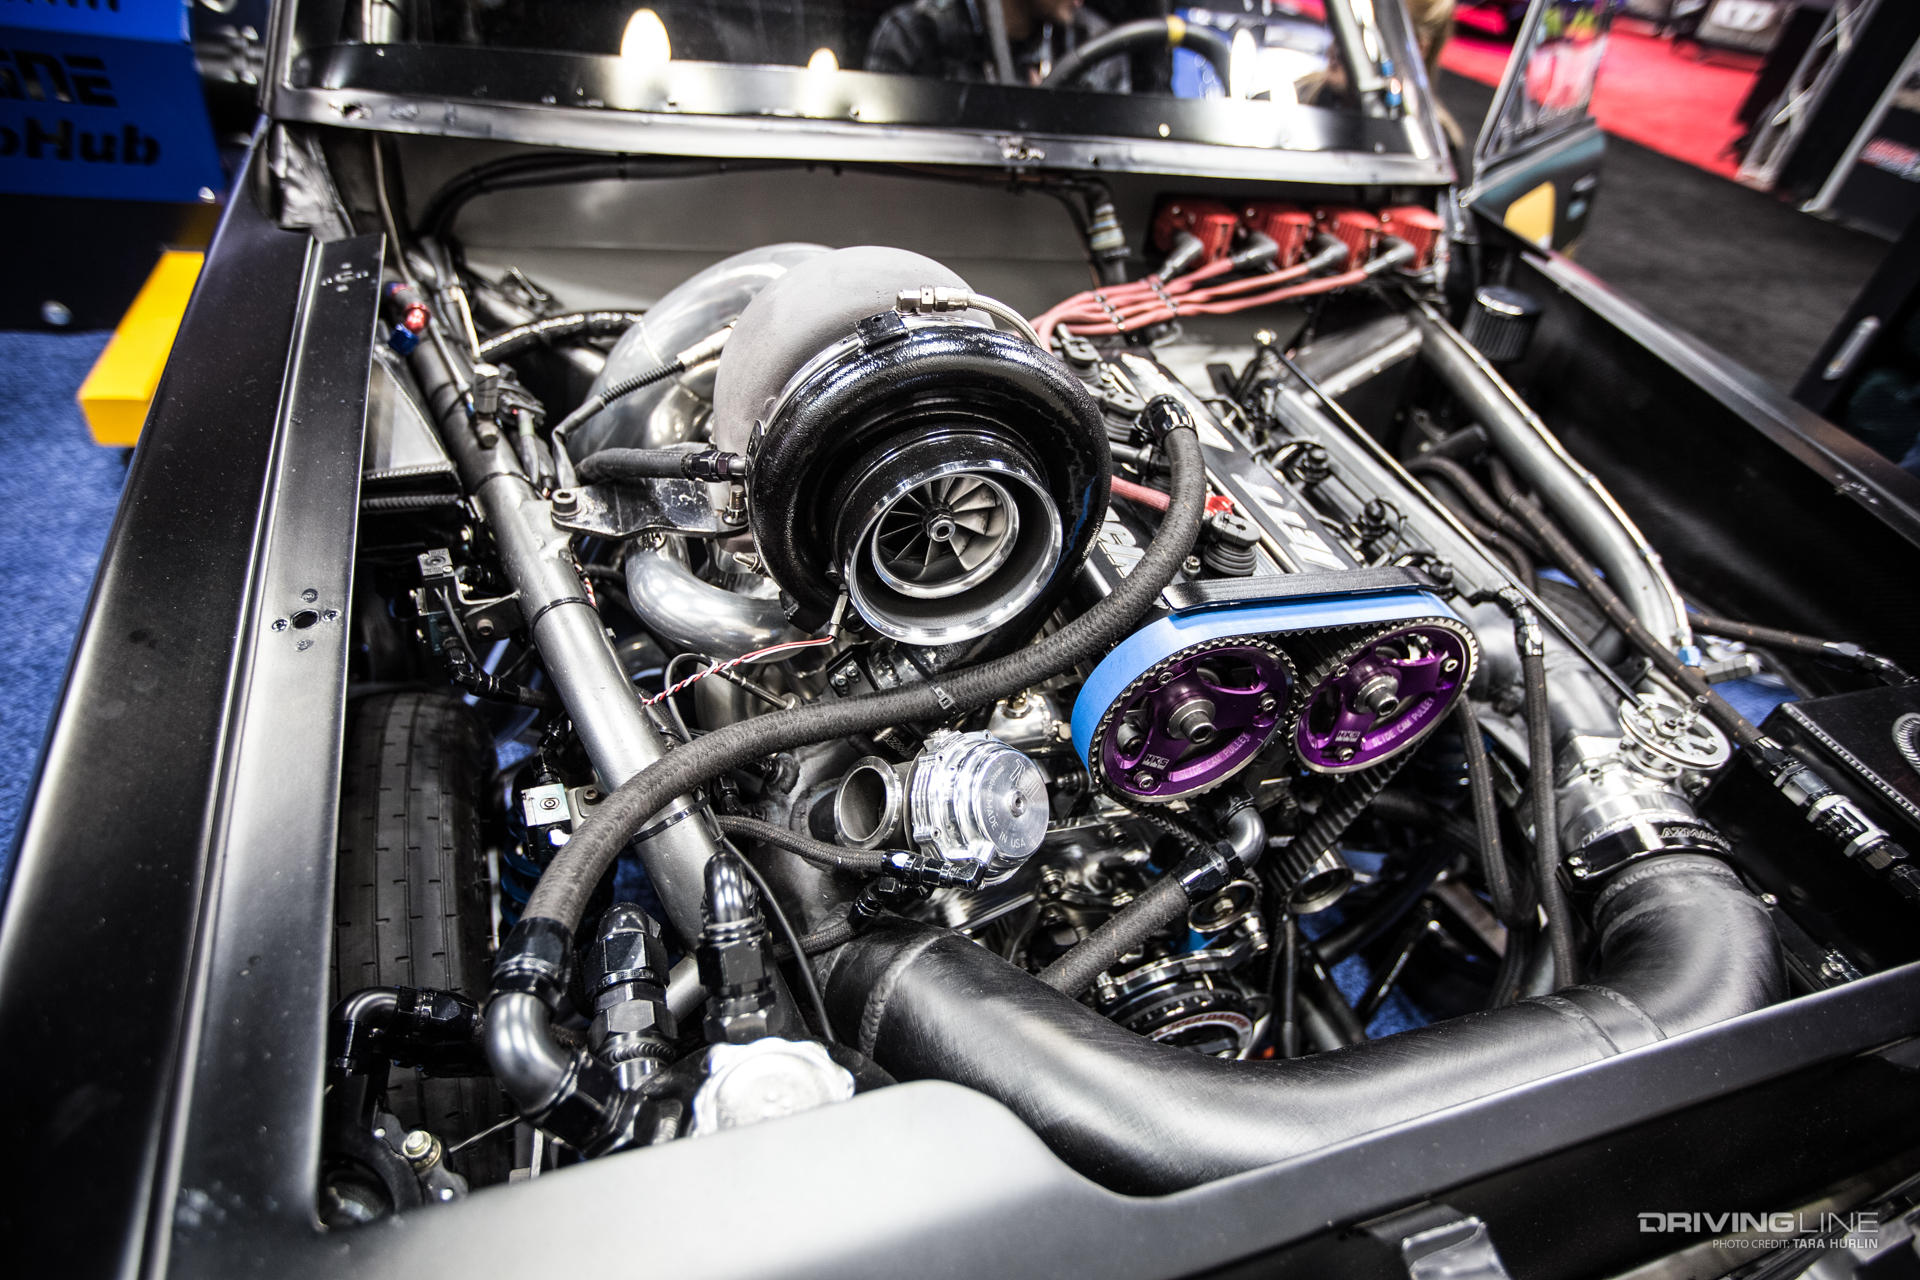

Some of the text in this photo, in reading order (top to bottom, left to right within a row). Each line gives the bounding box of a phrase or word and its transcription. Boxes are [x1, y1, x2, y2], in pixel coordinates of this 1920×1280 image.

[1335, 730, 1361, 742] HKS
[1371, 697, 1435, 747] SLIDE CAM PULLEY
[1141, 753, 1170, 770] HKS
[1179, 732, 1251, 779] SLIDE CAM PULLEY
[986, 799, 999, 831] MADE
[998, 831, 1009, 844] IN
[1010, 838, 1027, 849] USA
